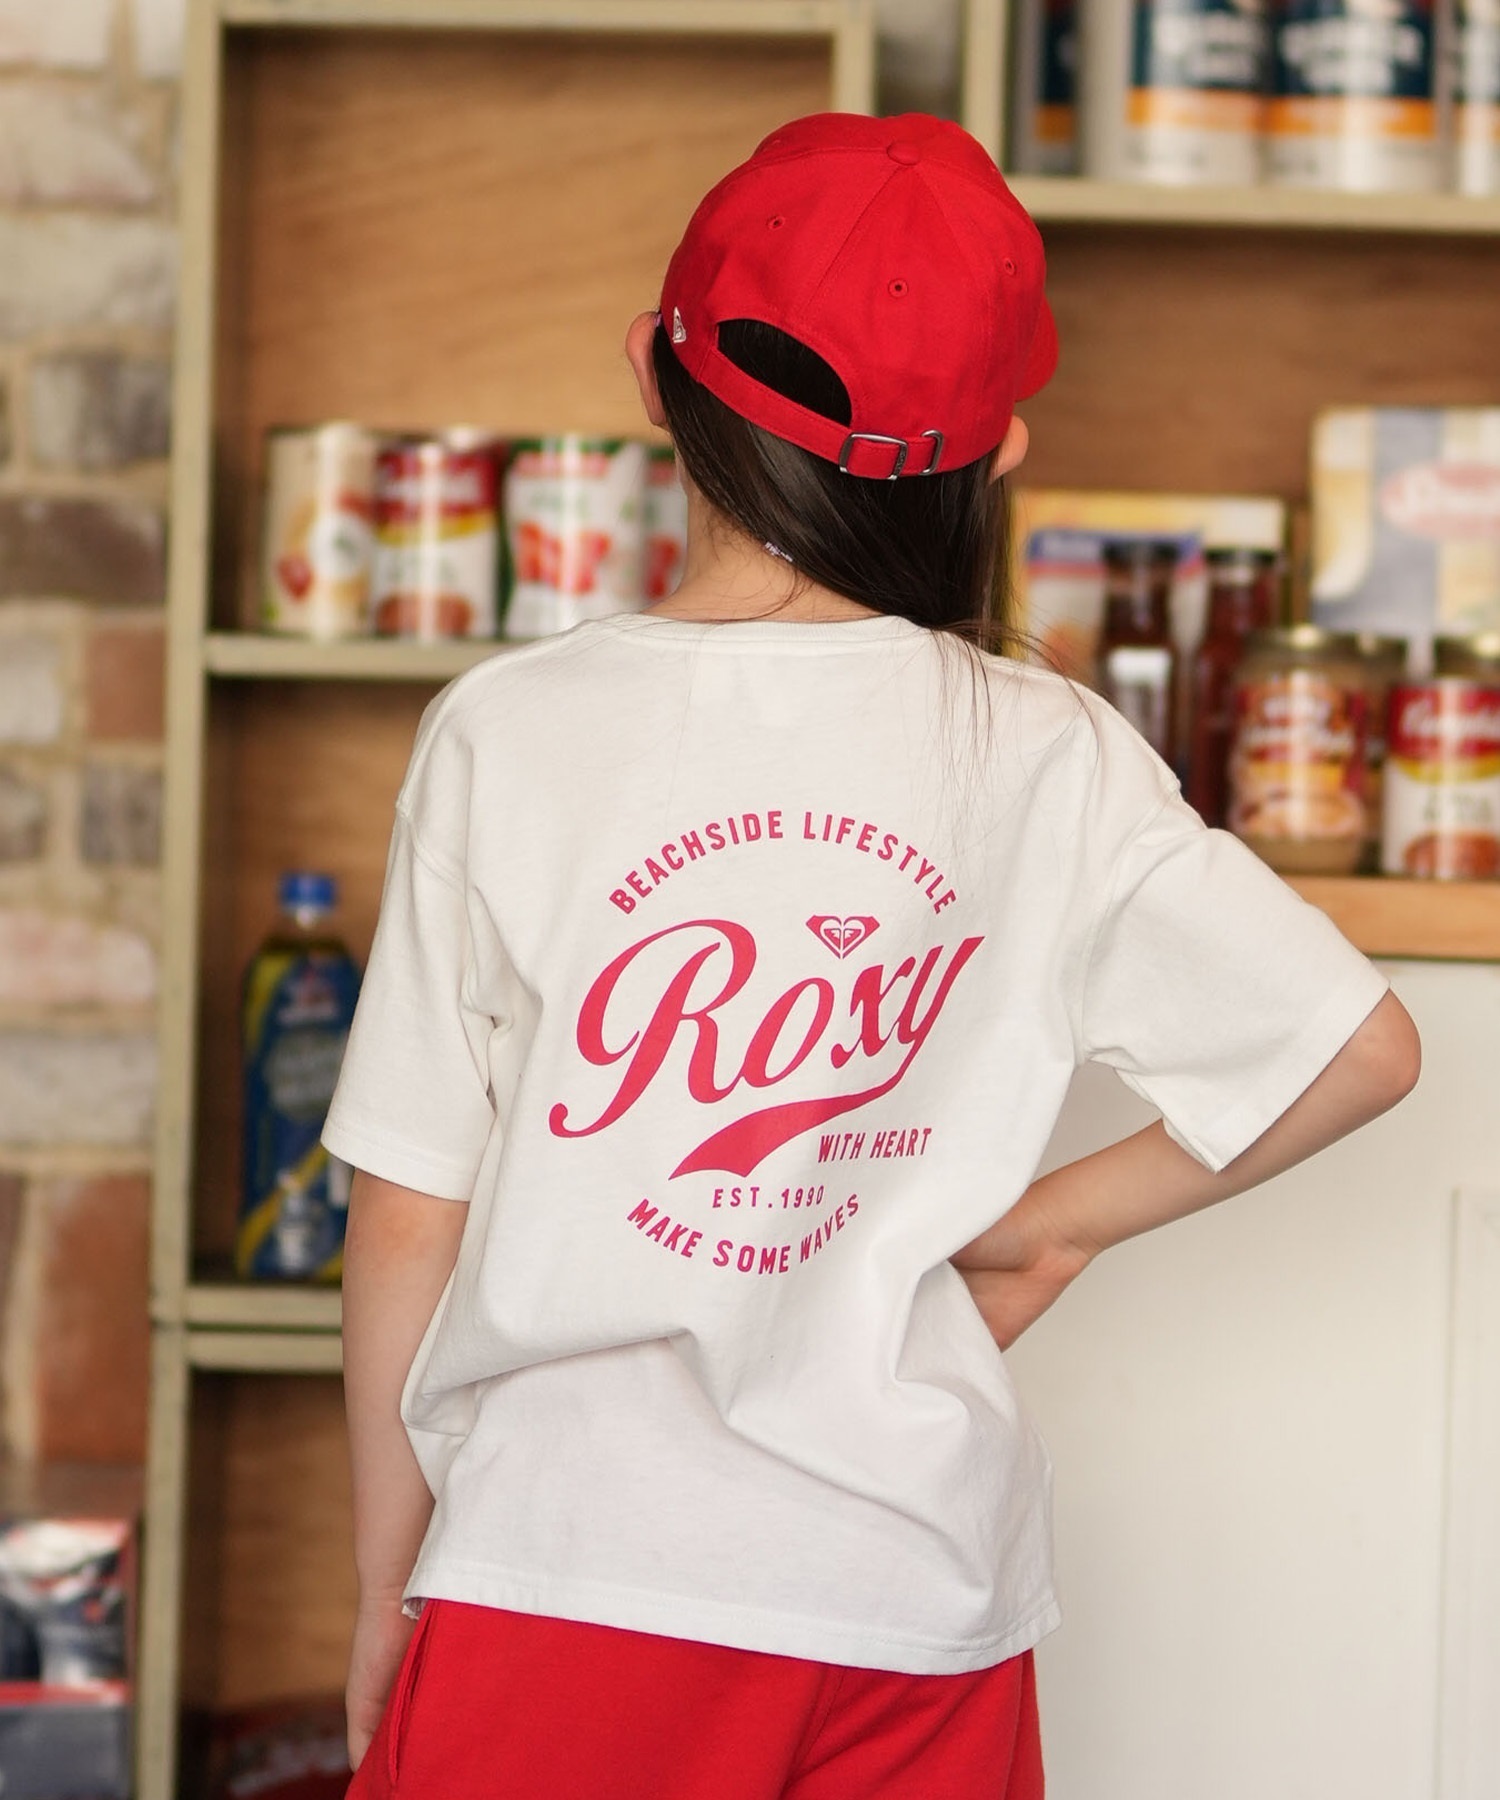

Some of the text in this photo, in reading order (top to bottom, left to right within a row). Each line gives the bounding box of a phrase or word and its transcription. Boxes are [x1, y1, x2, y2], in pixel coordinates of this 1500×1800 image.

[609, 811, 957, 914] BEACHSIDE LIFESTYLE
[548, 919, 985, 1179] Roxy
[818, 1127, 932, 1162] WITH HEART
[628, 1194, 860, 1275] MAKE SOME WAVES
